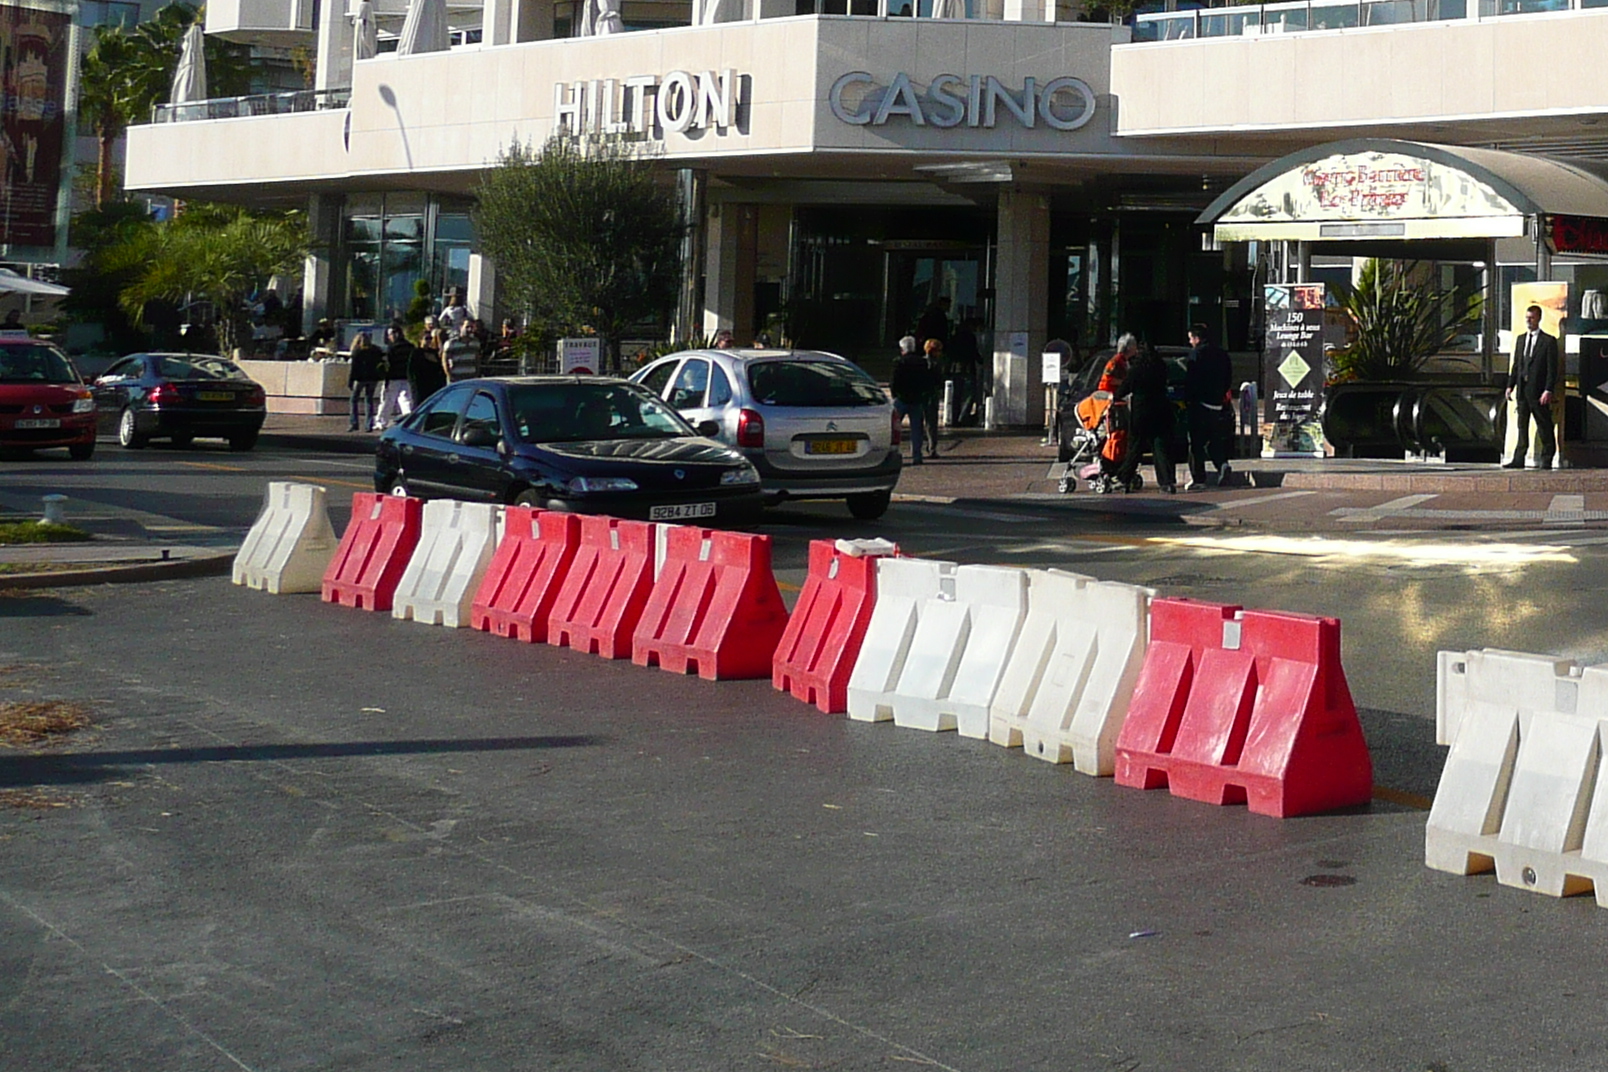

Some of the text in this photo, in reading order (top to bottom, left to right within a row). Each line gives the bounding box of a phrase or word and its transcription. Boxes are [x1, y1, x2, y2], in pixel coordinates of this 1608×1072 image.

[554, 69, 737, 137] HILTON
[829, 71, 1097, 130] CASINO
[1286, 312, 1304, 323] 150
[1270, 323, 1300, 332] Machines
[1276, 331, 1314, 341] Lounge Bar
[1273, 389, 1314, 400] Jeux de table
[653, 503, 714, 519] 9284 ZT 06
